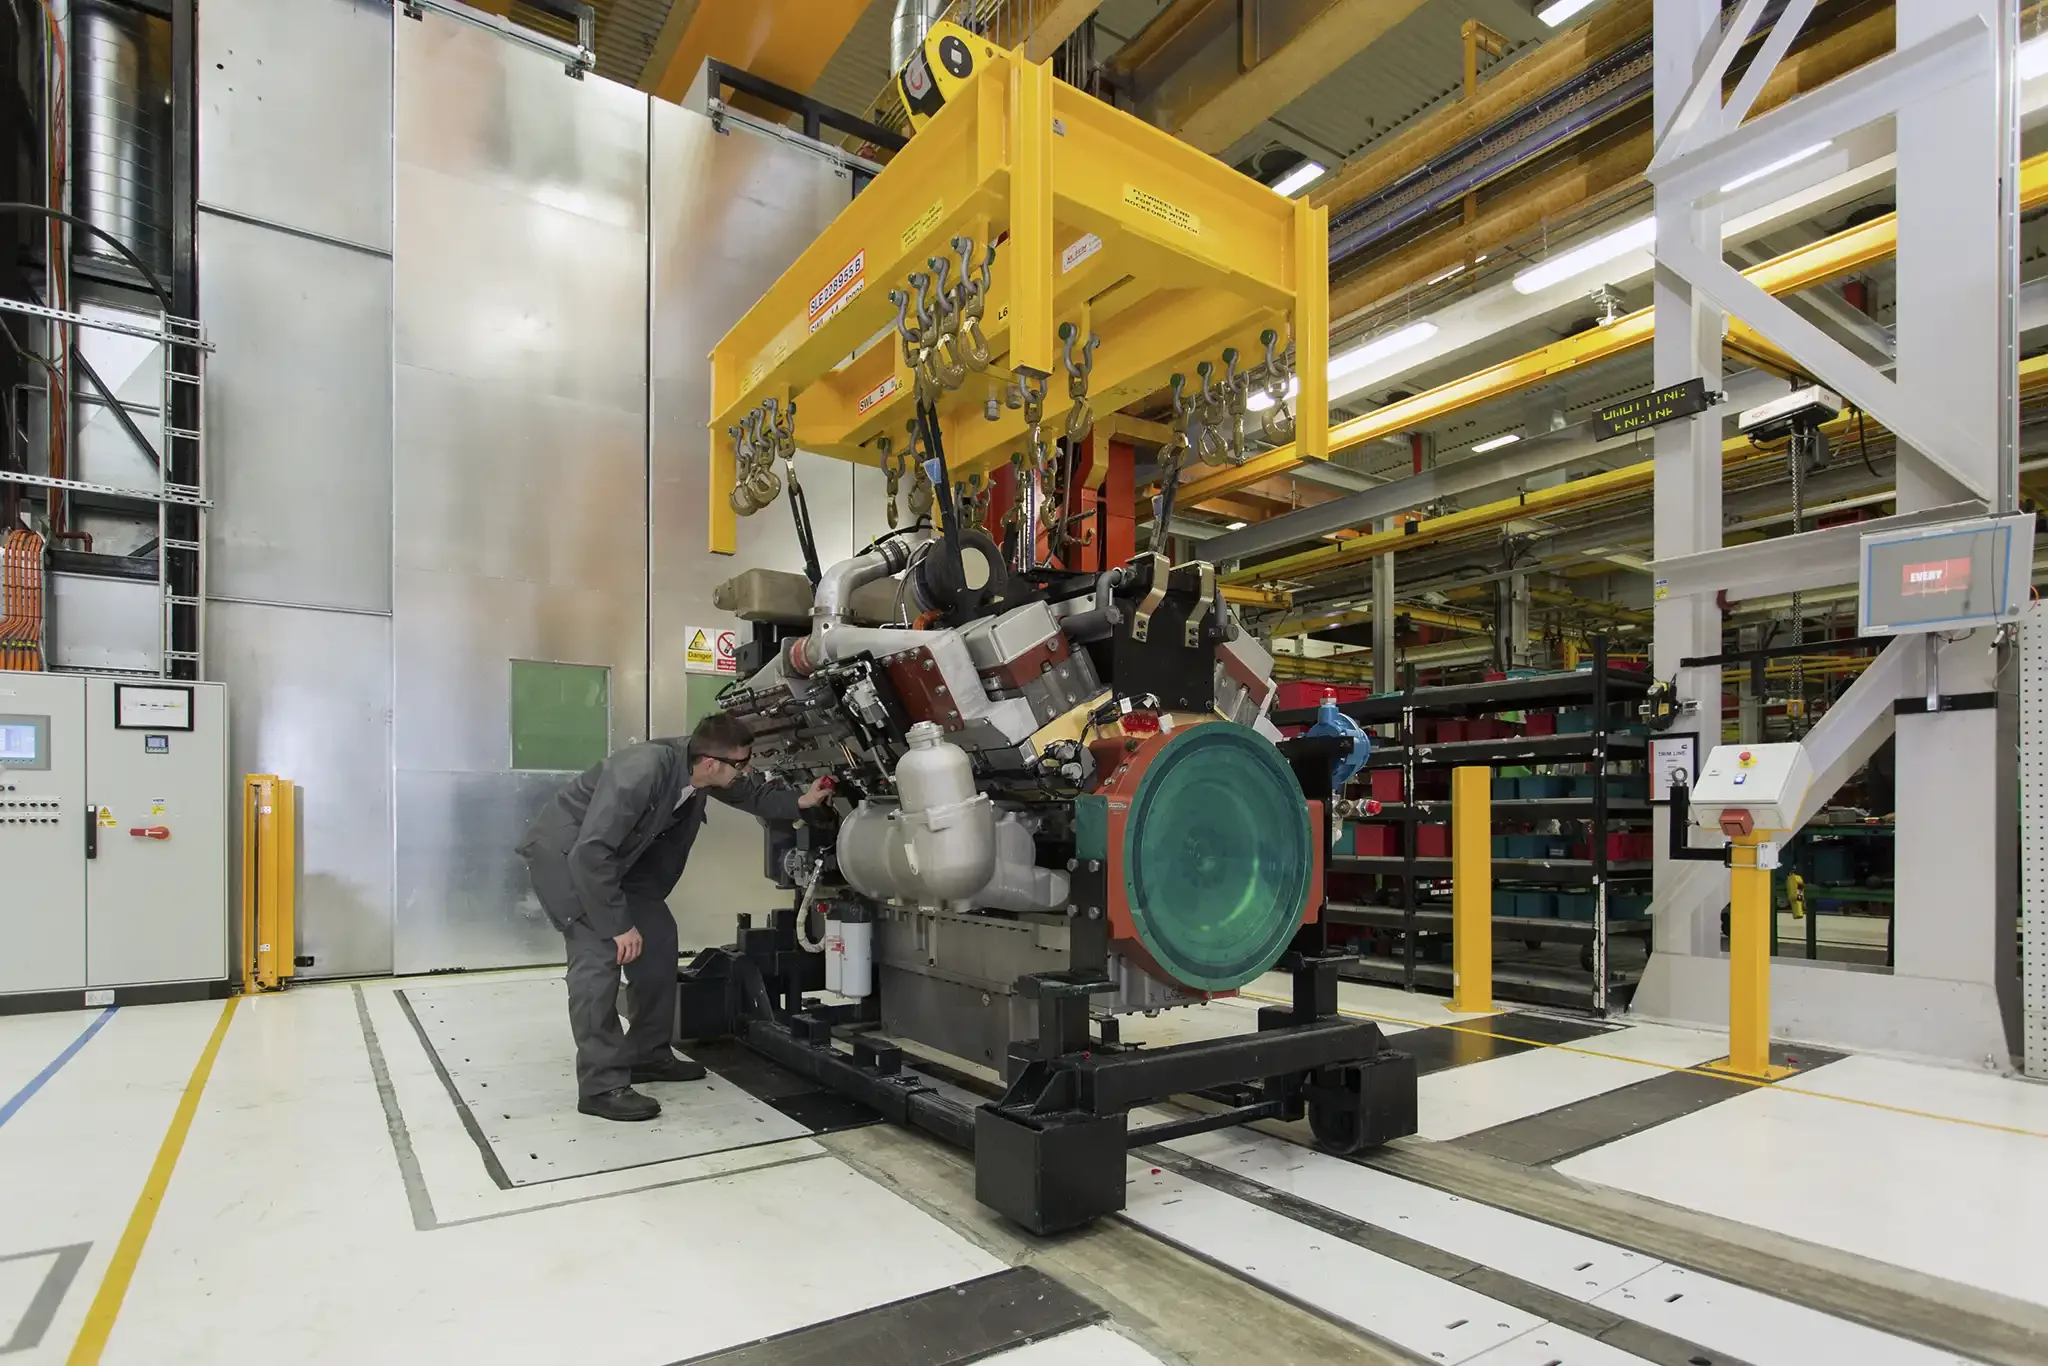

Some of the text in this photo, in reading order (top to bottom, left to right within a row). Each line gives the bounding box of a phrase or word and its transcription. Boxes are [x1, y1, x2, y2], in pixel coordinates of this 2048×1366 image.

[1133, 189, 1173, 211] FLYWHEEL
[1135, 196, 1151, 206] FOR
[1168, 211, 1188, 224] WITH
[1168, 218, 1198, 234] CLUTCH
[860, 385, 885, 411] SWL 9
[1910, 570, 1943, 583] EVERY
[688, 651, 712, 660] Danger
